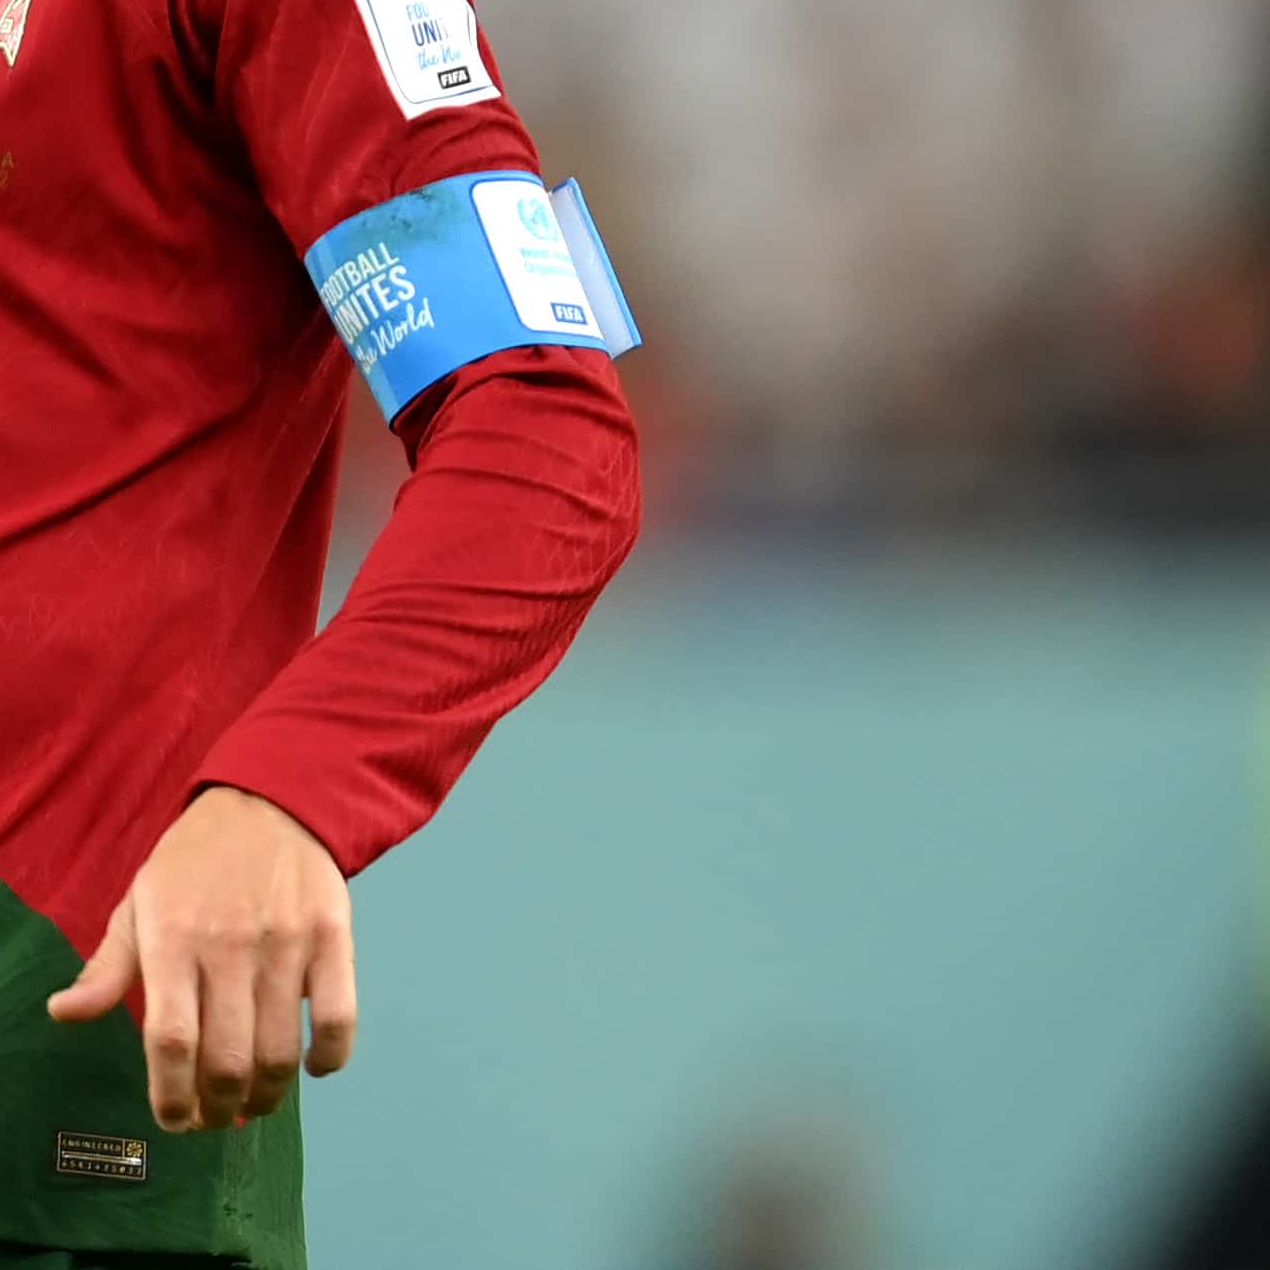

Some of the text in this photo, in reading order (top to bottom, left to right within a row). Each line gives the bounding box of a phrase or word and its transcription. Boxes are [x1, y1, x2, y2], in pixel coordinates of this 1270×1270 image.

[441, 70, 468, 88] FIFA
[333, 265, 416, 345] UNITES
[555, 304, 583, 323] FIFA
[370, 297, 435, 356] World
